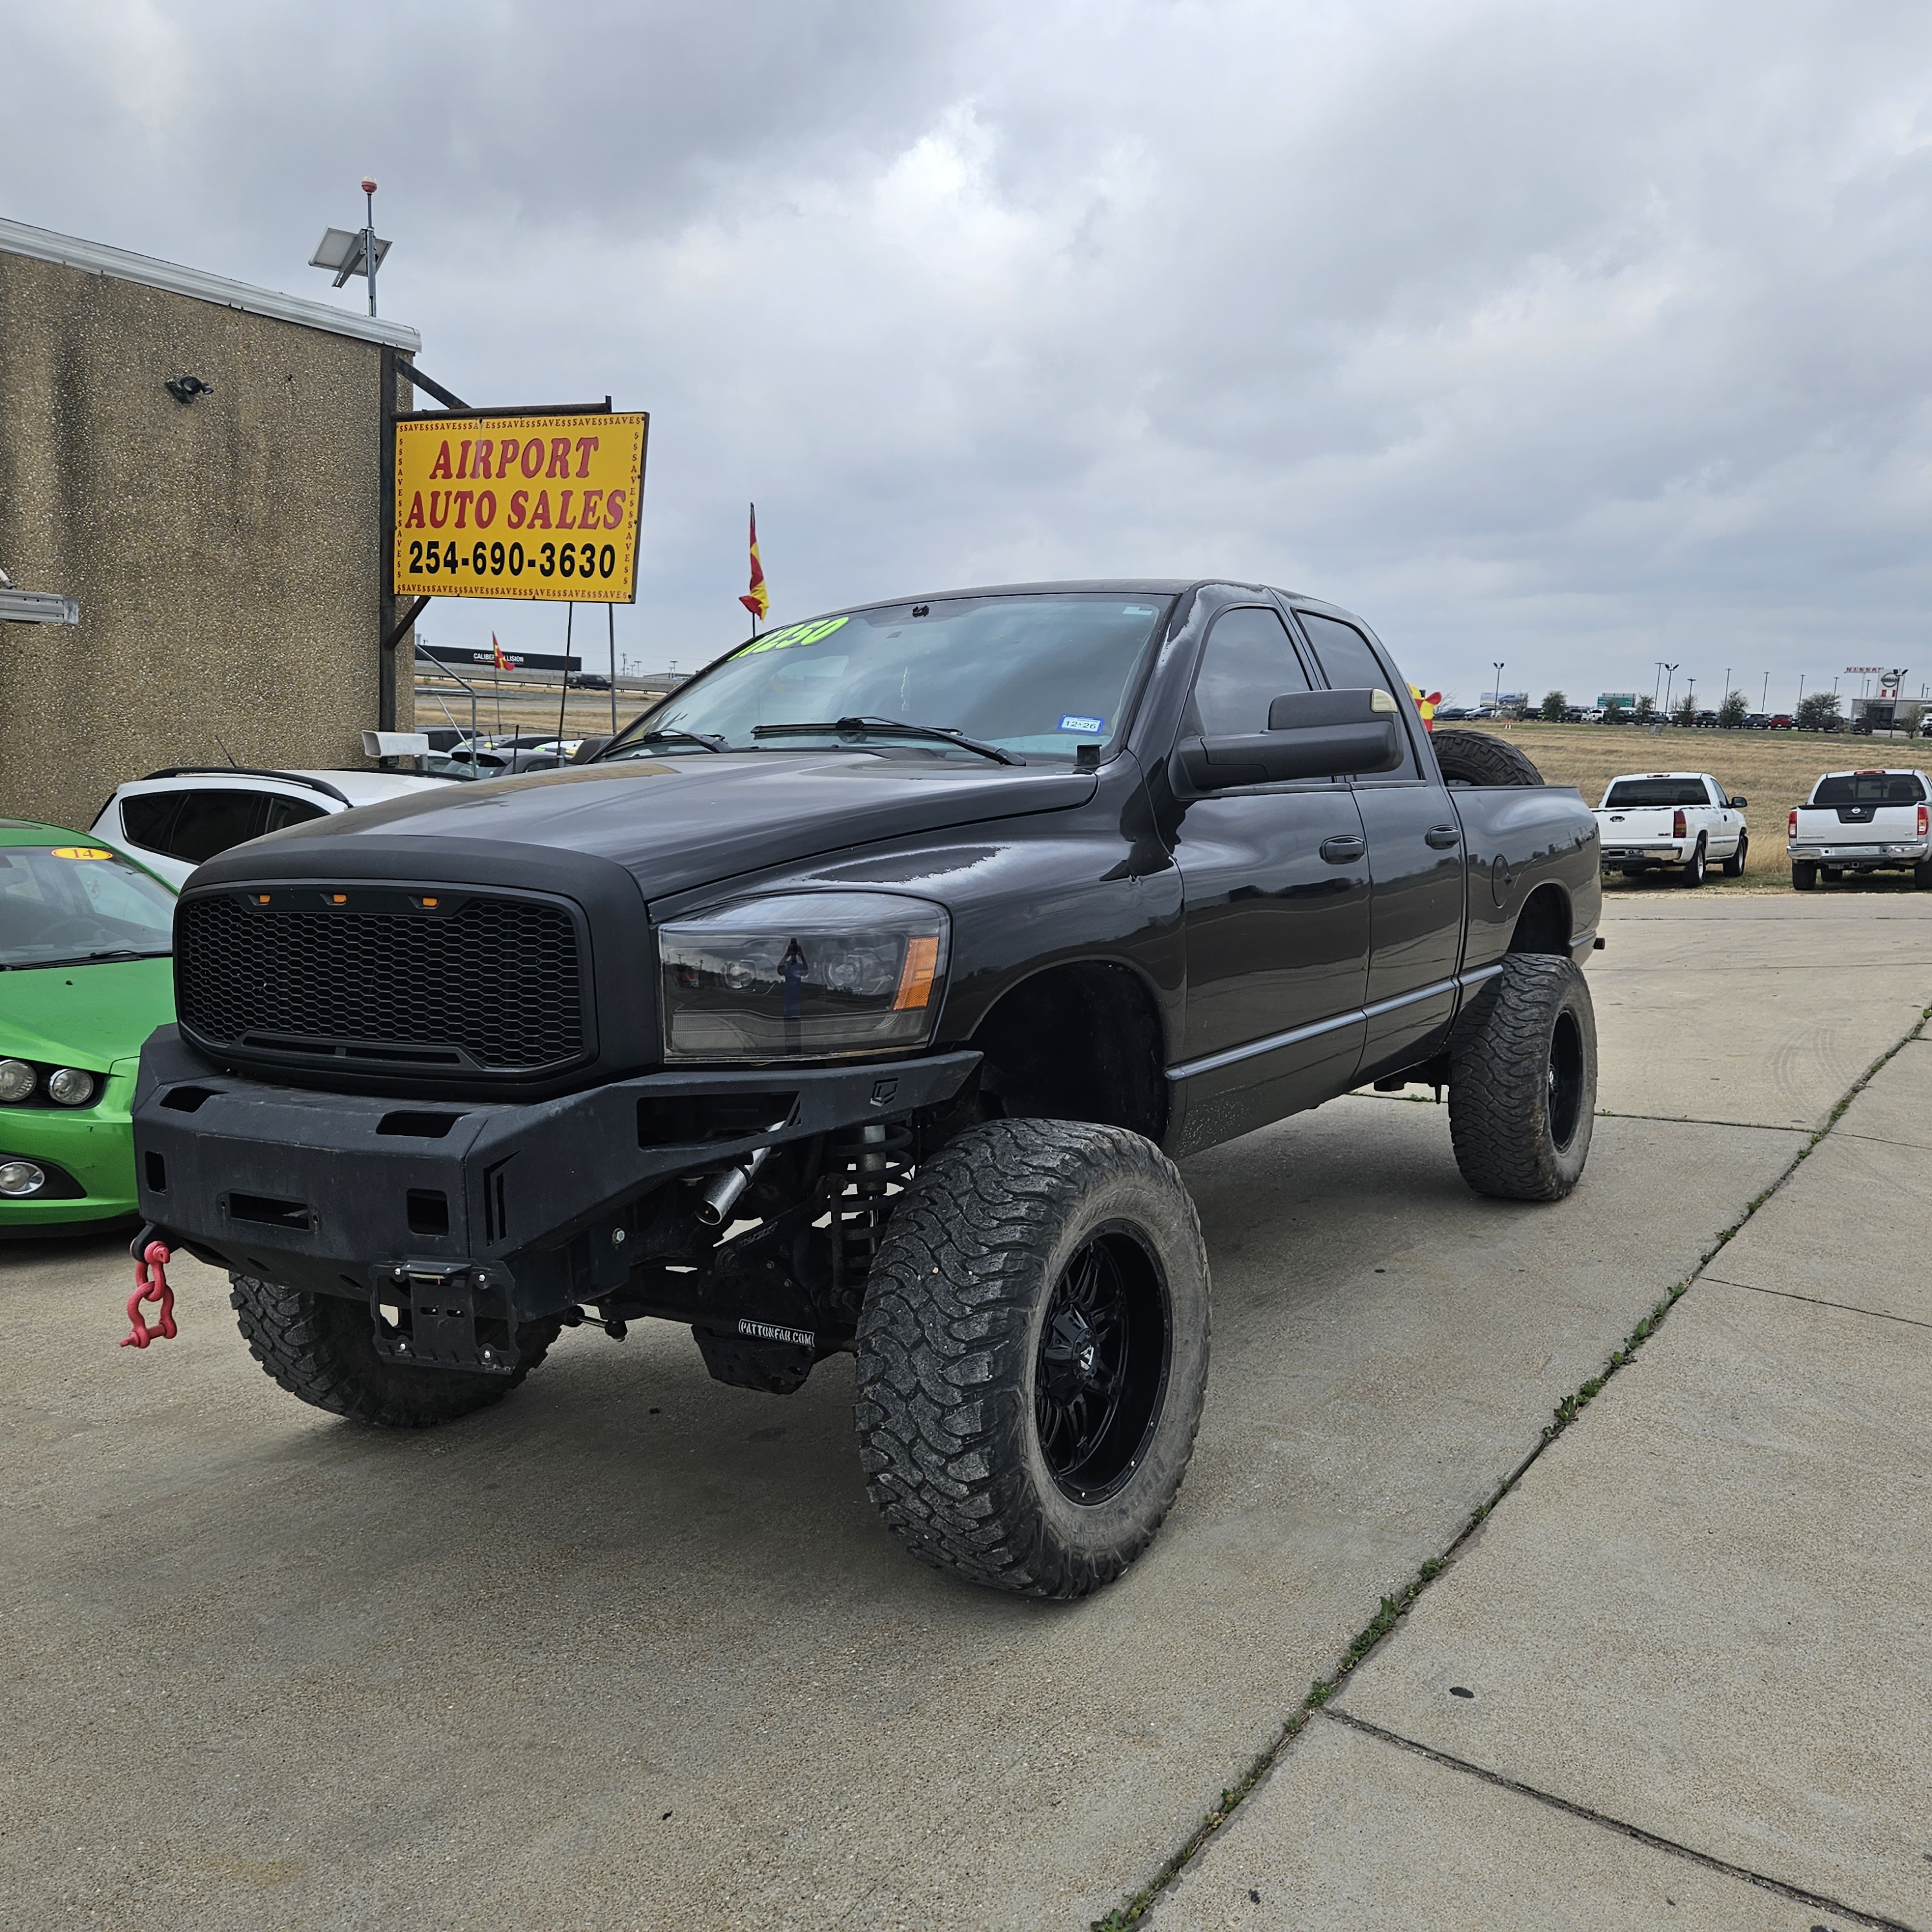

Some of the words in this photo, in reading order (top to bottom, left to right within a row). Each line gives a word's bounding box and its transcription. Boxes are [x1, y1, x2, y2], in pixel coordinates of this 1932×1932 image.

[429, 437, 599, 479] AIRPORT
[405, 490, 497, 529] AUTO
[508, 489, 626, 529] SALES
[409, 540, 615, 578] 254-690-3630
[72, 849, 94, 859] 14
